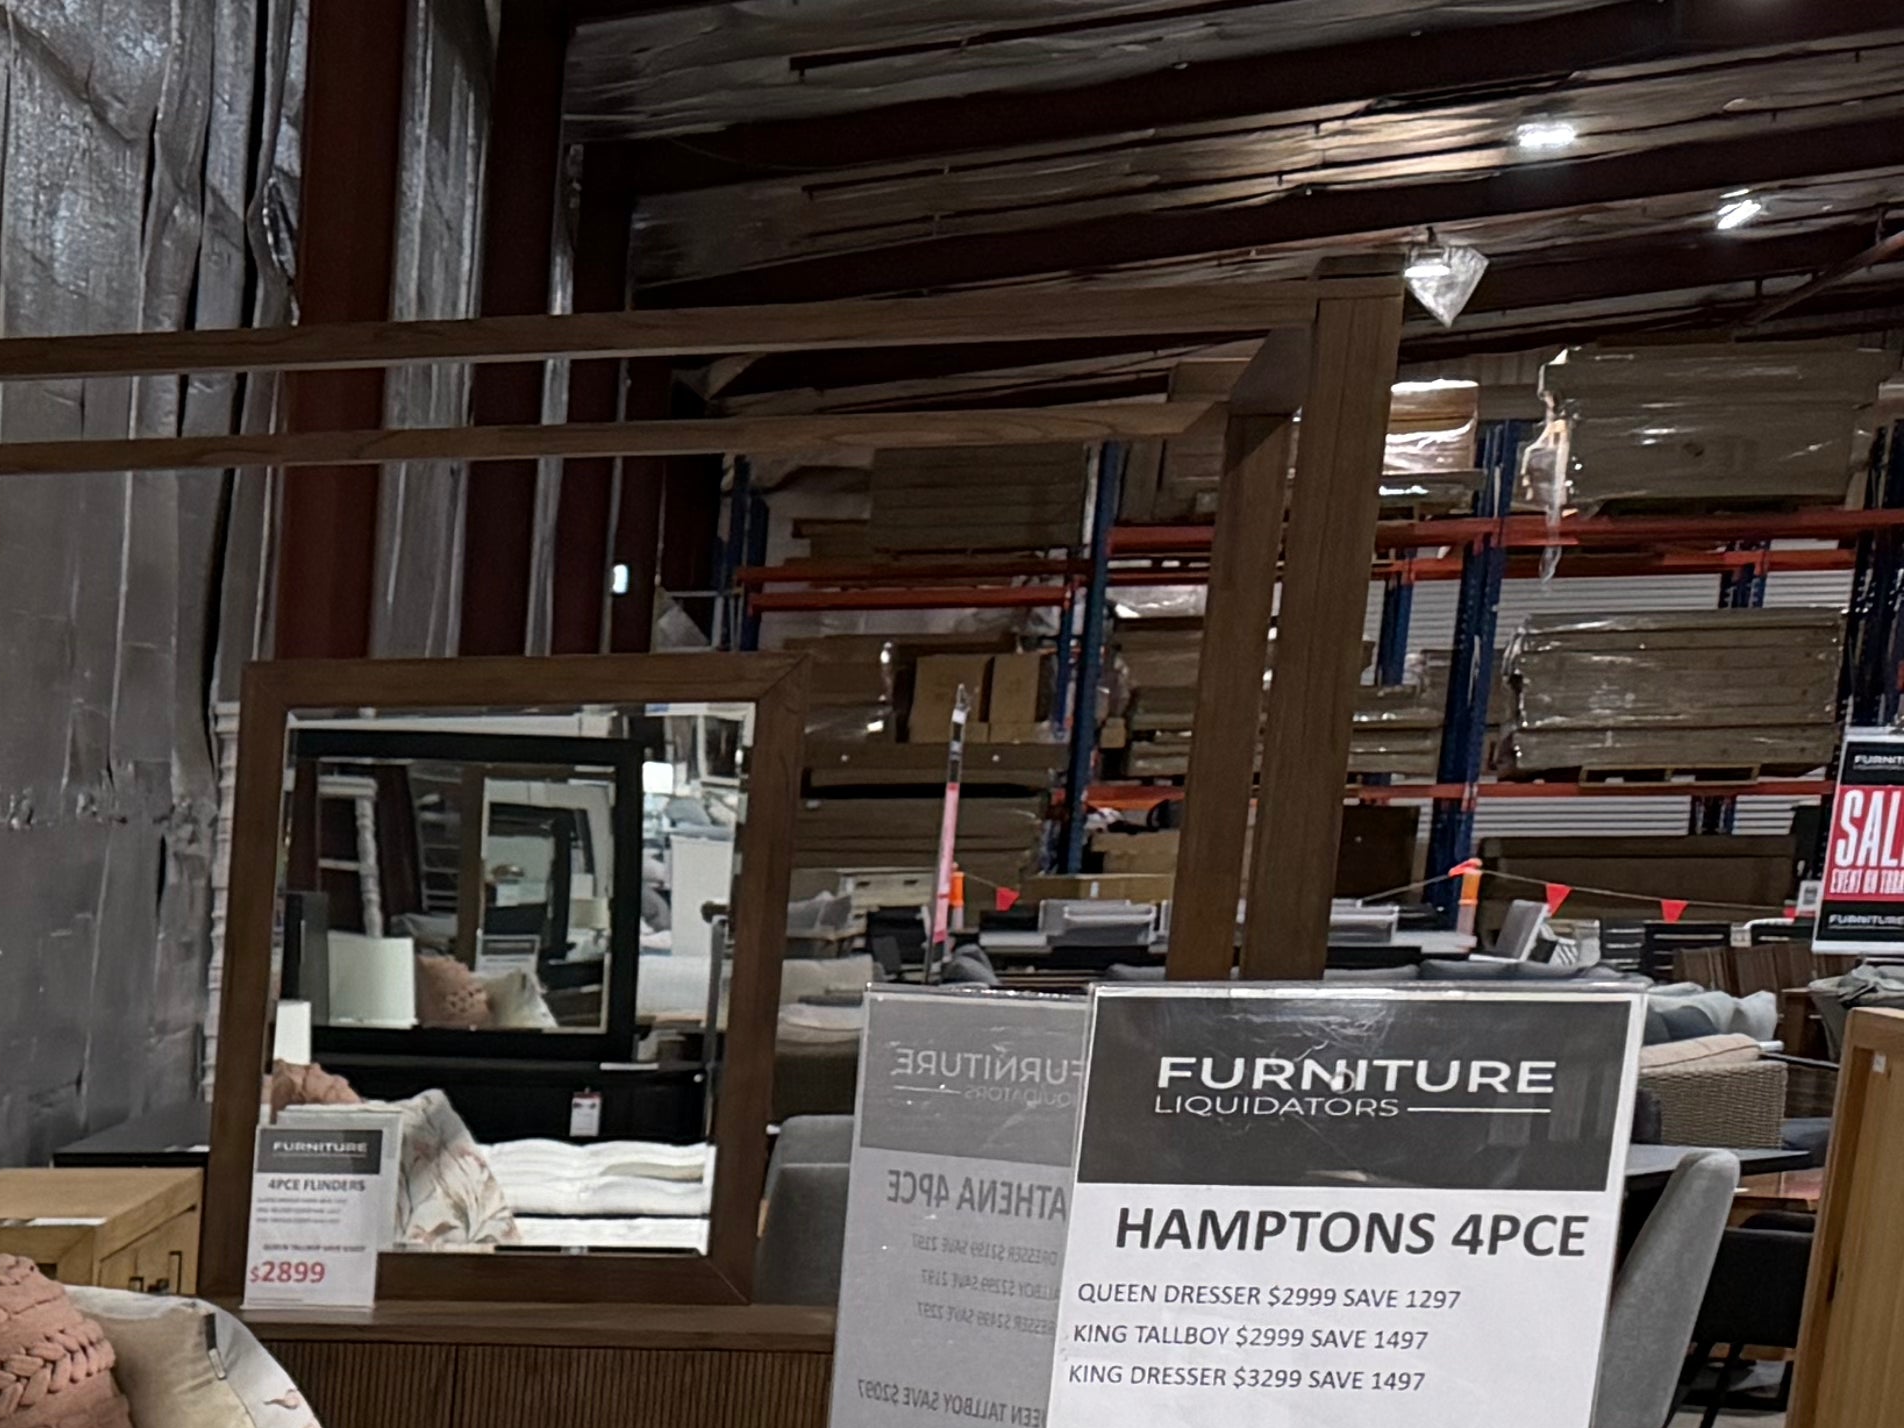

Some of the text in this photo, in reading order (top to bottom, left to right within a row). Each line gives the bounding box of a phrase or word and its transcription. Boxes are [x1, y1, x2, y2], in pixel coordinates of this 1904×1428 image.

[1834, 789, 1904, 868] SAL
[1156, 1056, 1558, 1095] FURNITURE
[1154, 1095, 1400, 1118] LIQUIDATORS
[272, 1141, 368, 1153] FURNITURE
[268, 1178, 366, 1192] 4PCE FLINDERS
[1115, 1207, 1591, 1257] HAMPTONS 4PCE
[249, 1260, 327, 1284] $2899
[1077, 1282, 1462, 1310] QUEEN DRESSER $2999 SAVE 1297
[1072, 1323, 1429, 1351] KING TALLBOY $2999 SAVE 1497
[1067, 1364, 1426, 1392] KING DRESSER $3299 SAVE 1497
